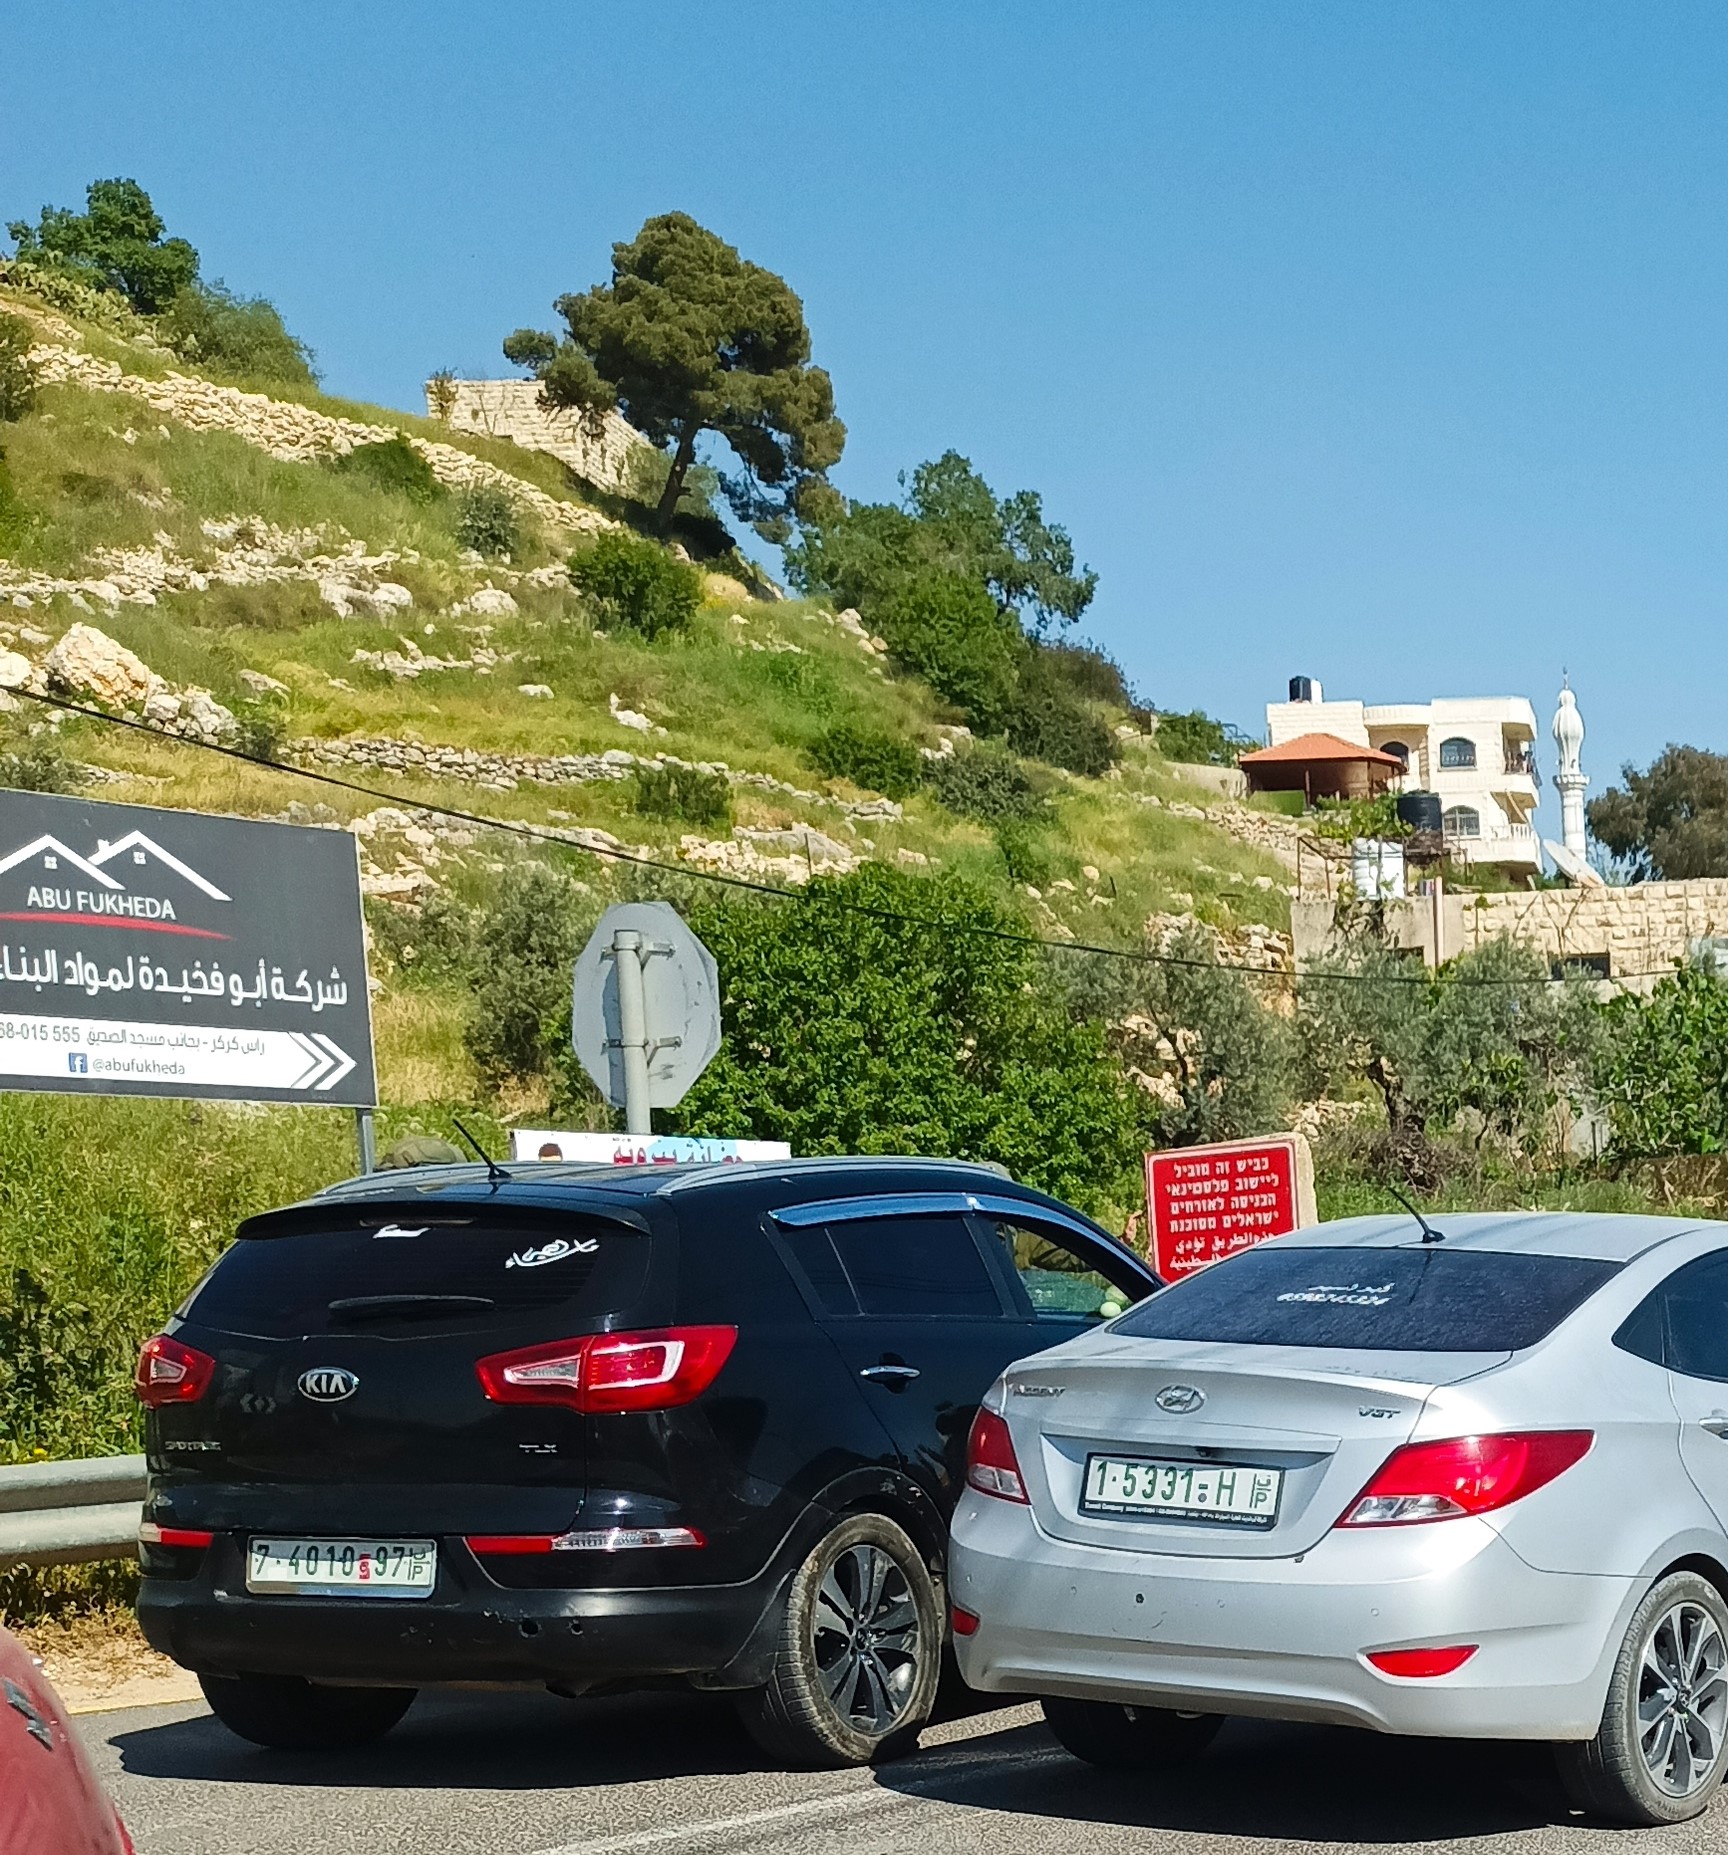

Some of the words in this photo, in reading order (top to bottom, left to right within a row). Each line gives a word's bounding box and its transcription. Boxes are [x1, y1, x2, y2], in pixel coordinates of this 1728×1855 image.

[27, 886, 71, 911] ABU
[77, 891, 177, 920] FUKHEDA
[64, 951, 134, 996] لمواد
[139, 955, 225, 1003] فخيدة
[229, 958, 268, 1008] أبو
[271, 965, 348, 1011] شركة
[53, 1025, 80, 1043] 555
[93, 1058, 185, 1075] @abufukheda
[1174, 1162, 1210, 1178] מוביל
[1215, 1161, 1230, 1175] זה
[1236, 1157, 1269, 1173] כביש
[1235, 1172, 1279, 1191] ליישוב
[1170, 1196, 1225, 1215] לאזרחים
[1230, 1193, 1276, 1209] הכניסה
[1170, 1217, 1216, 1233] מסוכנת
[1222, 1210, 1279, 1229] ישראלים
[305, 1374, 346, 1394] KIA
